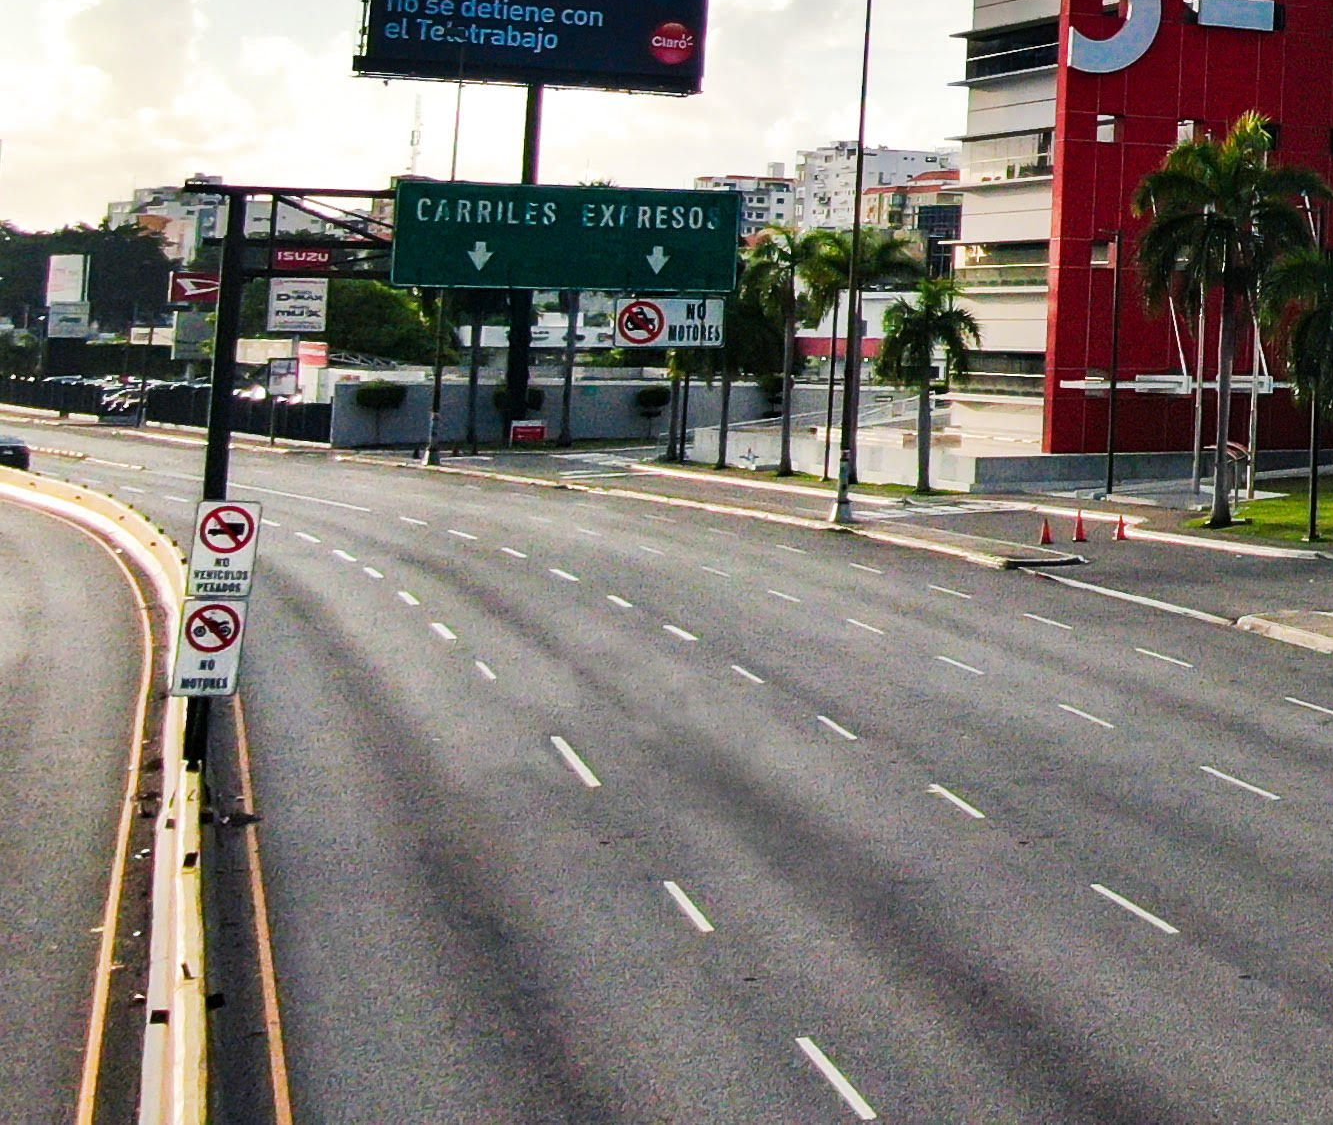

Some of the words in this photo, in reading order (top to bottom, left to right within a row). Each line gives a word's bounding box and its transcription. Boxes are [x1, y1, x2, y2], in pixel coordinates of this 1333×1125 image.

[561, 8, 604, 27] con
[384, 17, 409, 39] el
[417, 197, 557, 226] CARRILES
[277, 251, 329, 262] ISUZU
[686, 303, 706, 321] NO
[667, 324, 720, 342] MOTORES
[214, 557, 229, 567] NO
[198, 659, 216, 671] NO
[181, 676, 228, 690] MOTORES
